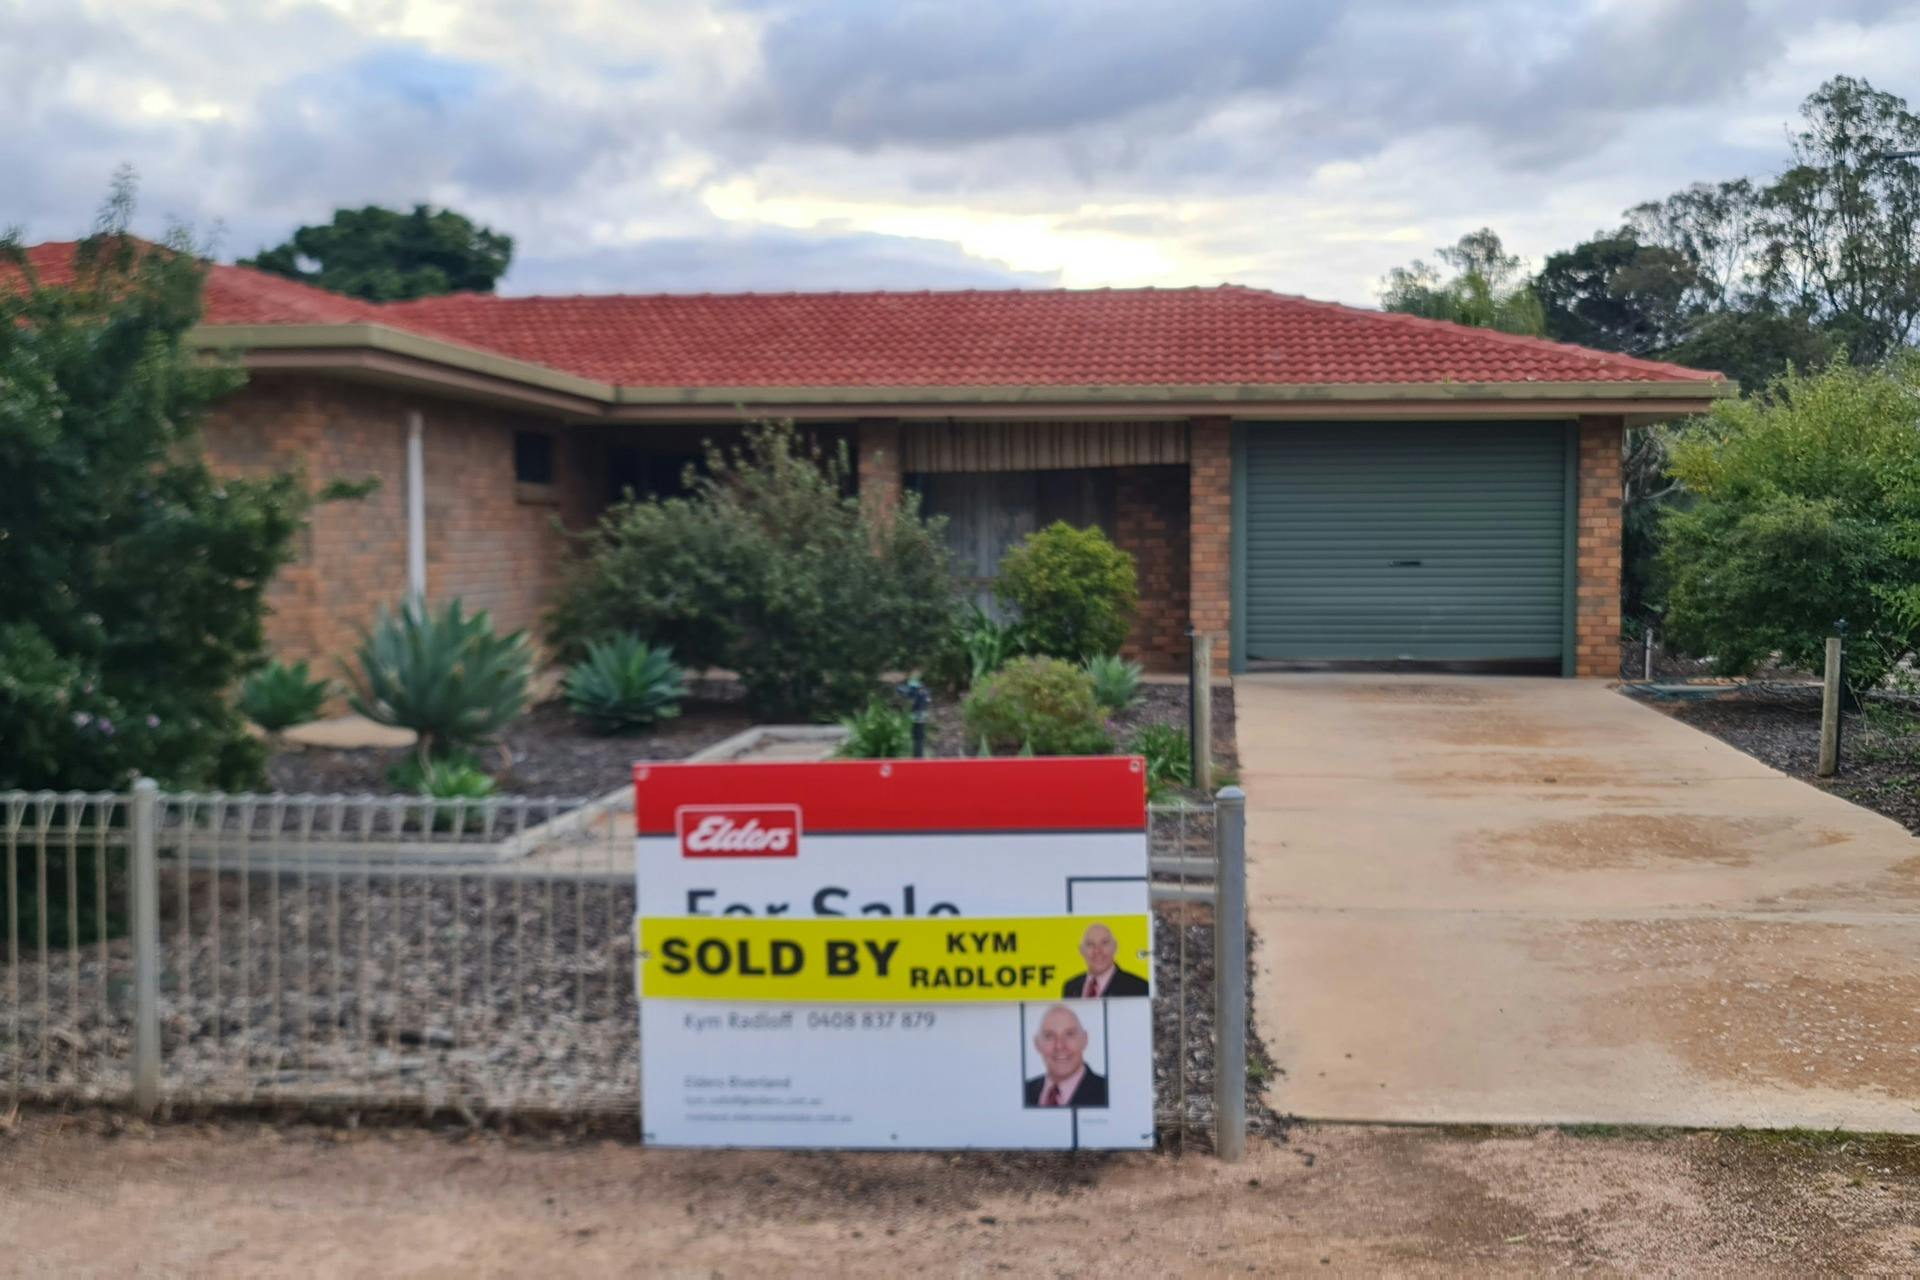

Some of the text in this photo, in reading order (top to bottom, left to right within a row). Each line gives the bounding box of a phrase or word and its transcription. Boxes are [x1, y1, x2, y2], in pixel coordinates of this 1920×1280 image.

[686, 815, 793, 852] Elders
[946, 931, 1018, 954] KYM
[660, 937, 900, 978] SOLD BY
[910, 964, 1056, 989] RADLOFF
[684, 1010, 936, 1032] Kym Radloff 0408 837 879
